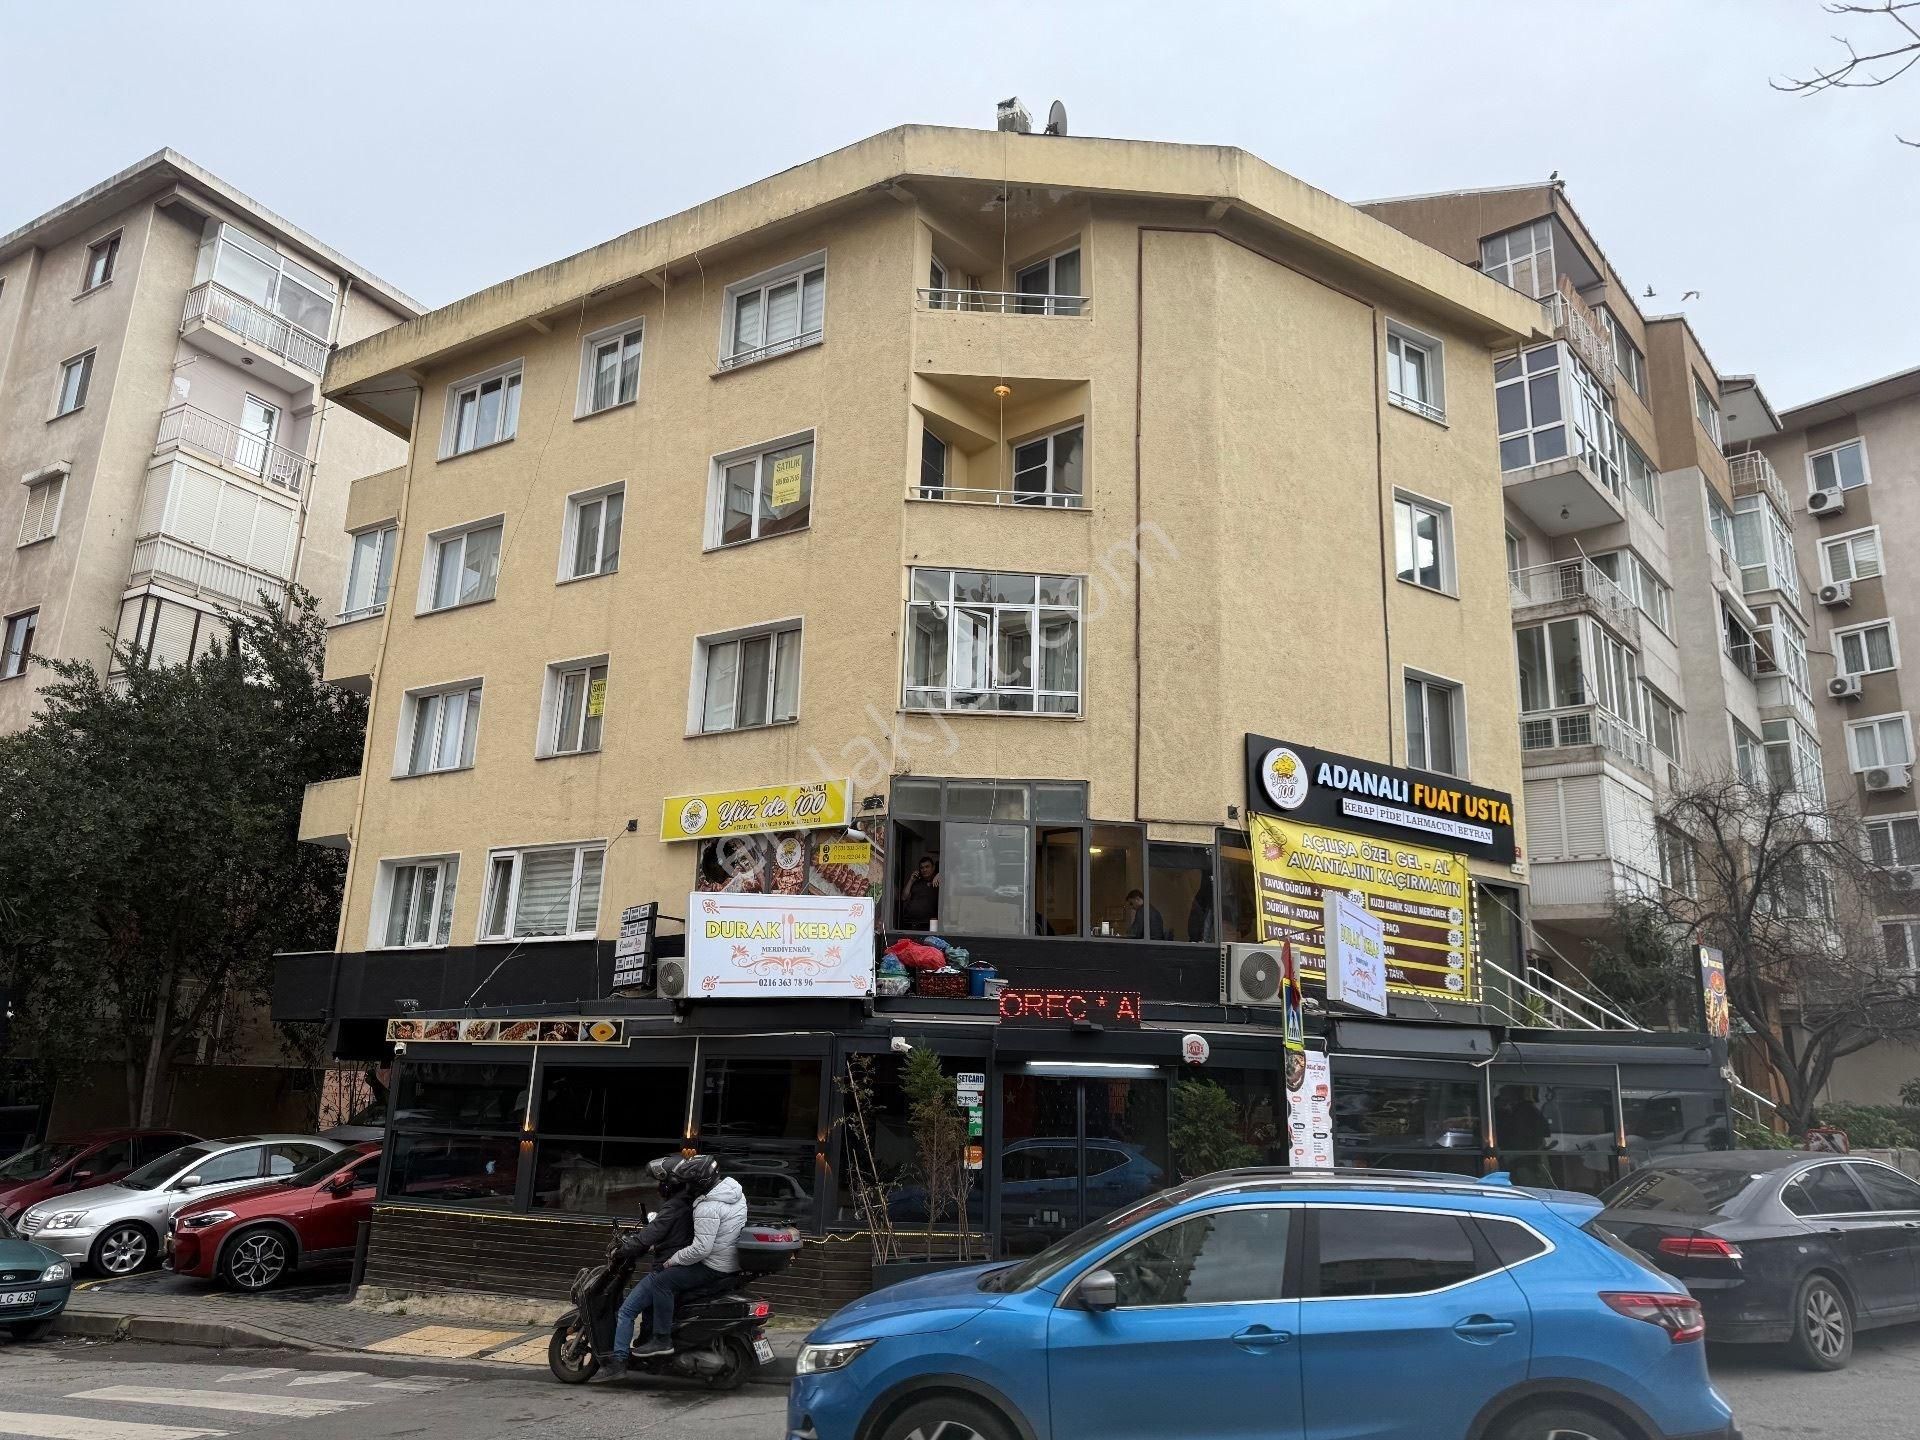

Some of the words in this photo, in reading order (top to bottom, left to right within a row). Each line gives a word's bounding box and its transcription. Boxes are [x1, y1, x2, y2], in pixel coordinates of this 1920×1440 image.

[777, 458, 800, 473] SATILIK
[1277, 785, 1295, 799] 100
[1317, 762, 1409, 803] ADANALI
[1414, 783, 1461, 814] FUAT
[1465, 794, 1511, 825] USTA
[792, 792, 827, 817] 100
[1344, 801, 1375, 816] KEBAP
[1380, 808, 1401, 822] PİDE
[1406, 814, 1454, 833] LAHMACUN
[1457, 826, 1491, 841] BEYRAN
[1302, 833, 1358, 858] AÇILIŞA
[1361, 841, 1392, 864] ÖZEL
[1396, 852, 1421, 870] GEL
[1433, 860, 1450, 875] AL
[1288, 852, 1374, 882] AVANTAJINI
[1377, 867, 1461, 897] KAÇIRMAYIN
[1264, 878, 1285, 891] TAVUK
[1285, 882, 1311, 896] DÜRÜM
[1266, 900, 1290, 915] DÜRÜM
[1296, 908, 1319, 921] AYRAN
[1370, 898, 1385, 908] KUZU
[1404, 904, 1418, 915] SULU
[1419, 906, 1447, 919] MERCİMEK
[705, 920, 782, 939] DURAK
[794, 921, 857, 940] KEBAP
[758, 979, 777, 987] 0216
[778, 979, 792, 987] 363
[794, 979, 802, 987] 78
[804, 979, 813, 987] 96
[958, 1074, 984, 1083] SETCARD
[17, 1292, 35, 1302] 439
